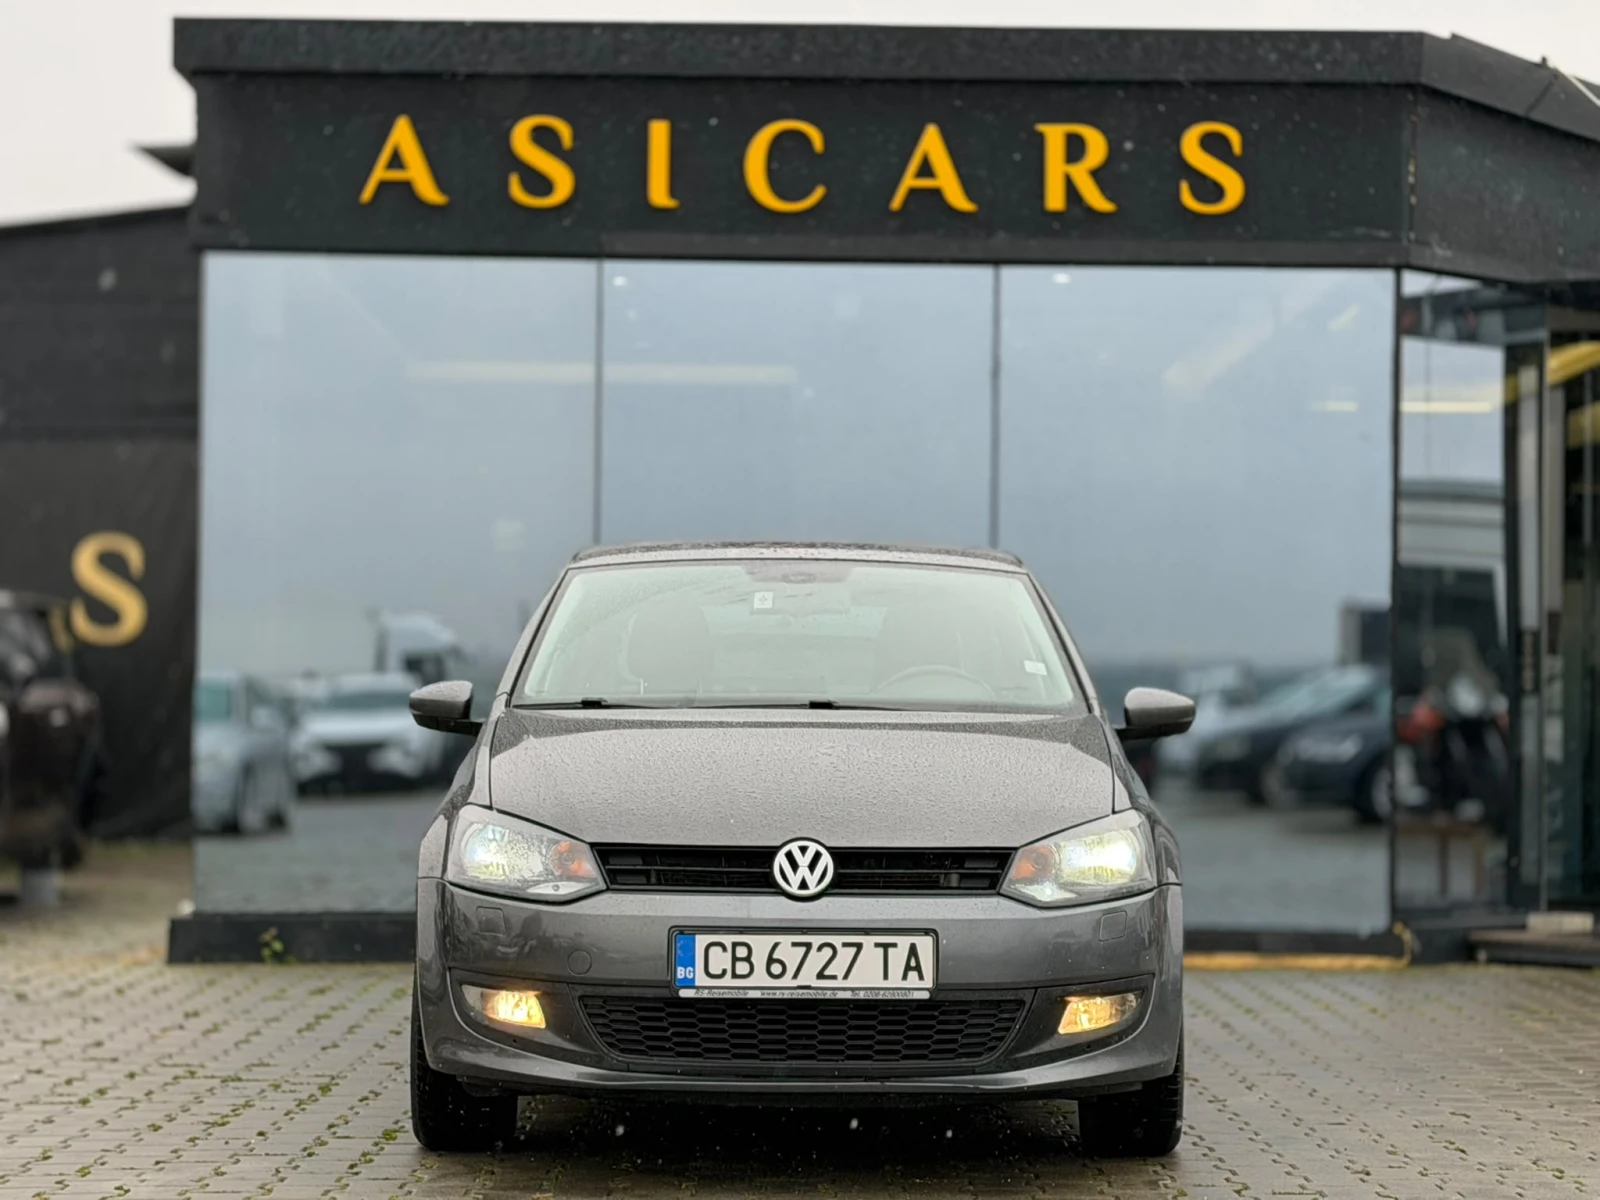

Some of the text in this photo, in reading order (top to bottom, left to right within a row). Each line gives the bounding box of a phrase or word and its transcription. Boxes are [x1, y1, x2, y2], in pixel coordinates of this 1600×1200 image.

[359, 113, 1248, 216] ASICARS
[773, 840, 834, 897] VW
[676, 966, 694, 979] BG
[703, 941, 925, 982] CB 6727 TA
